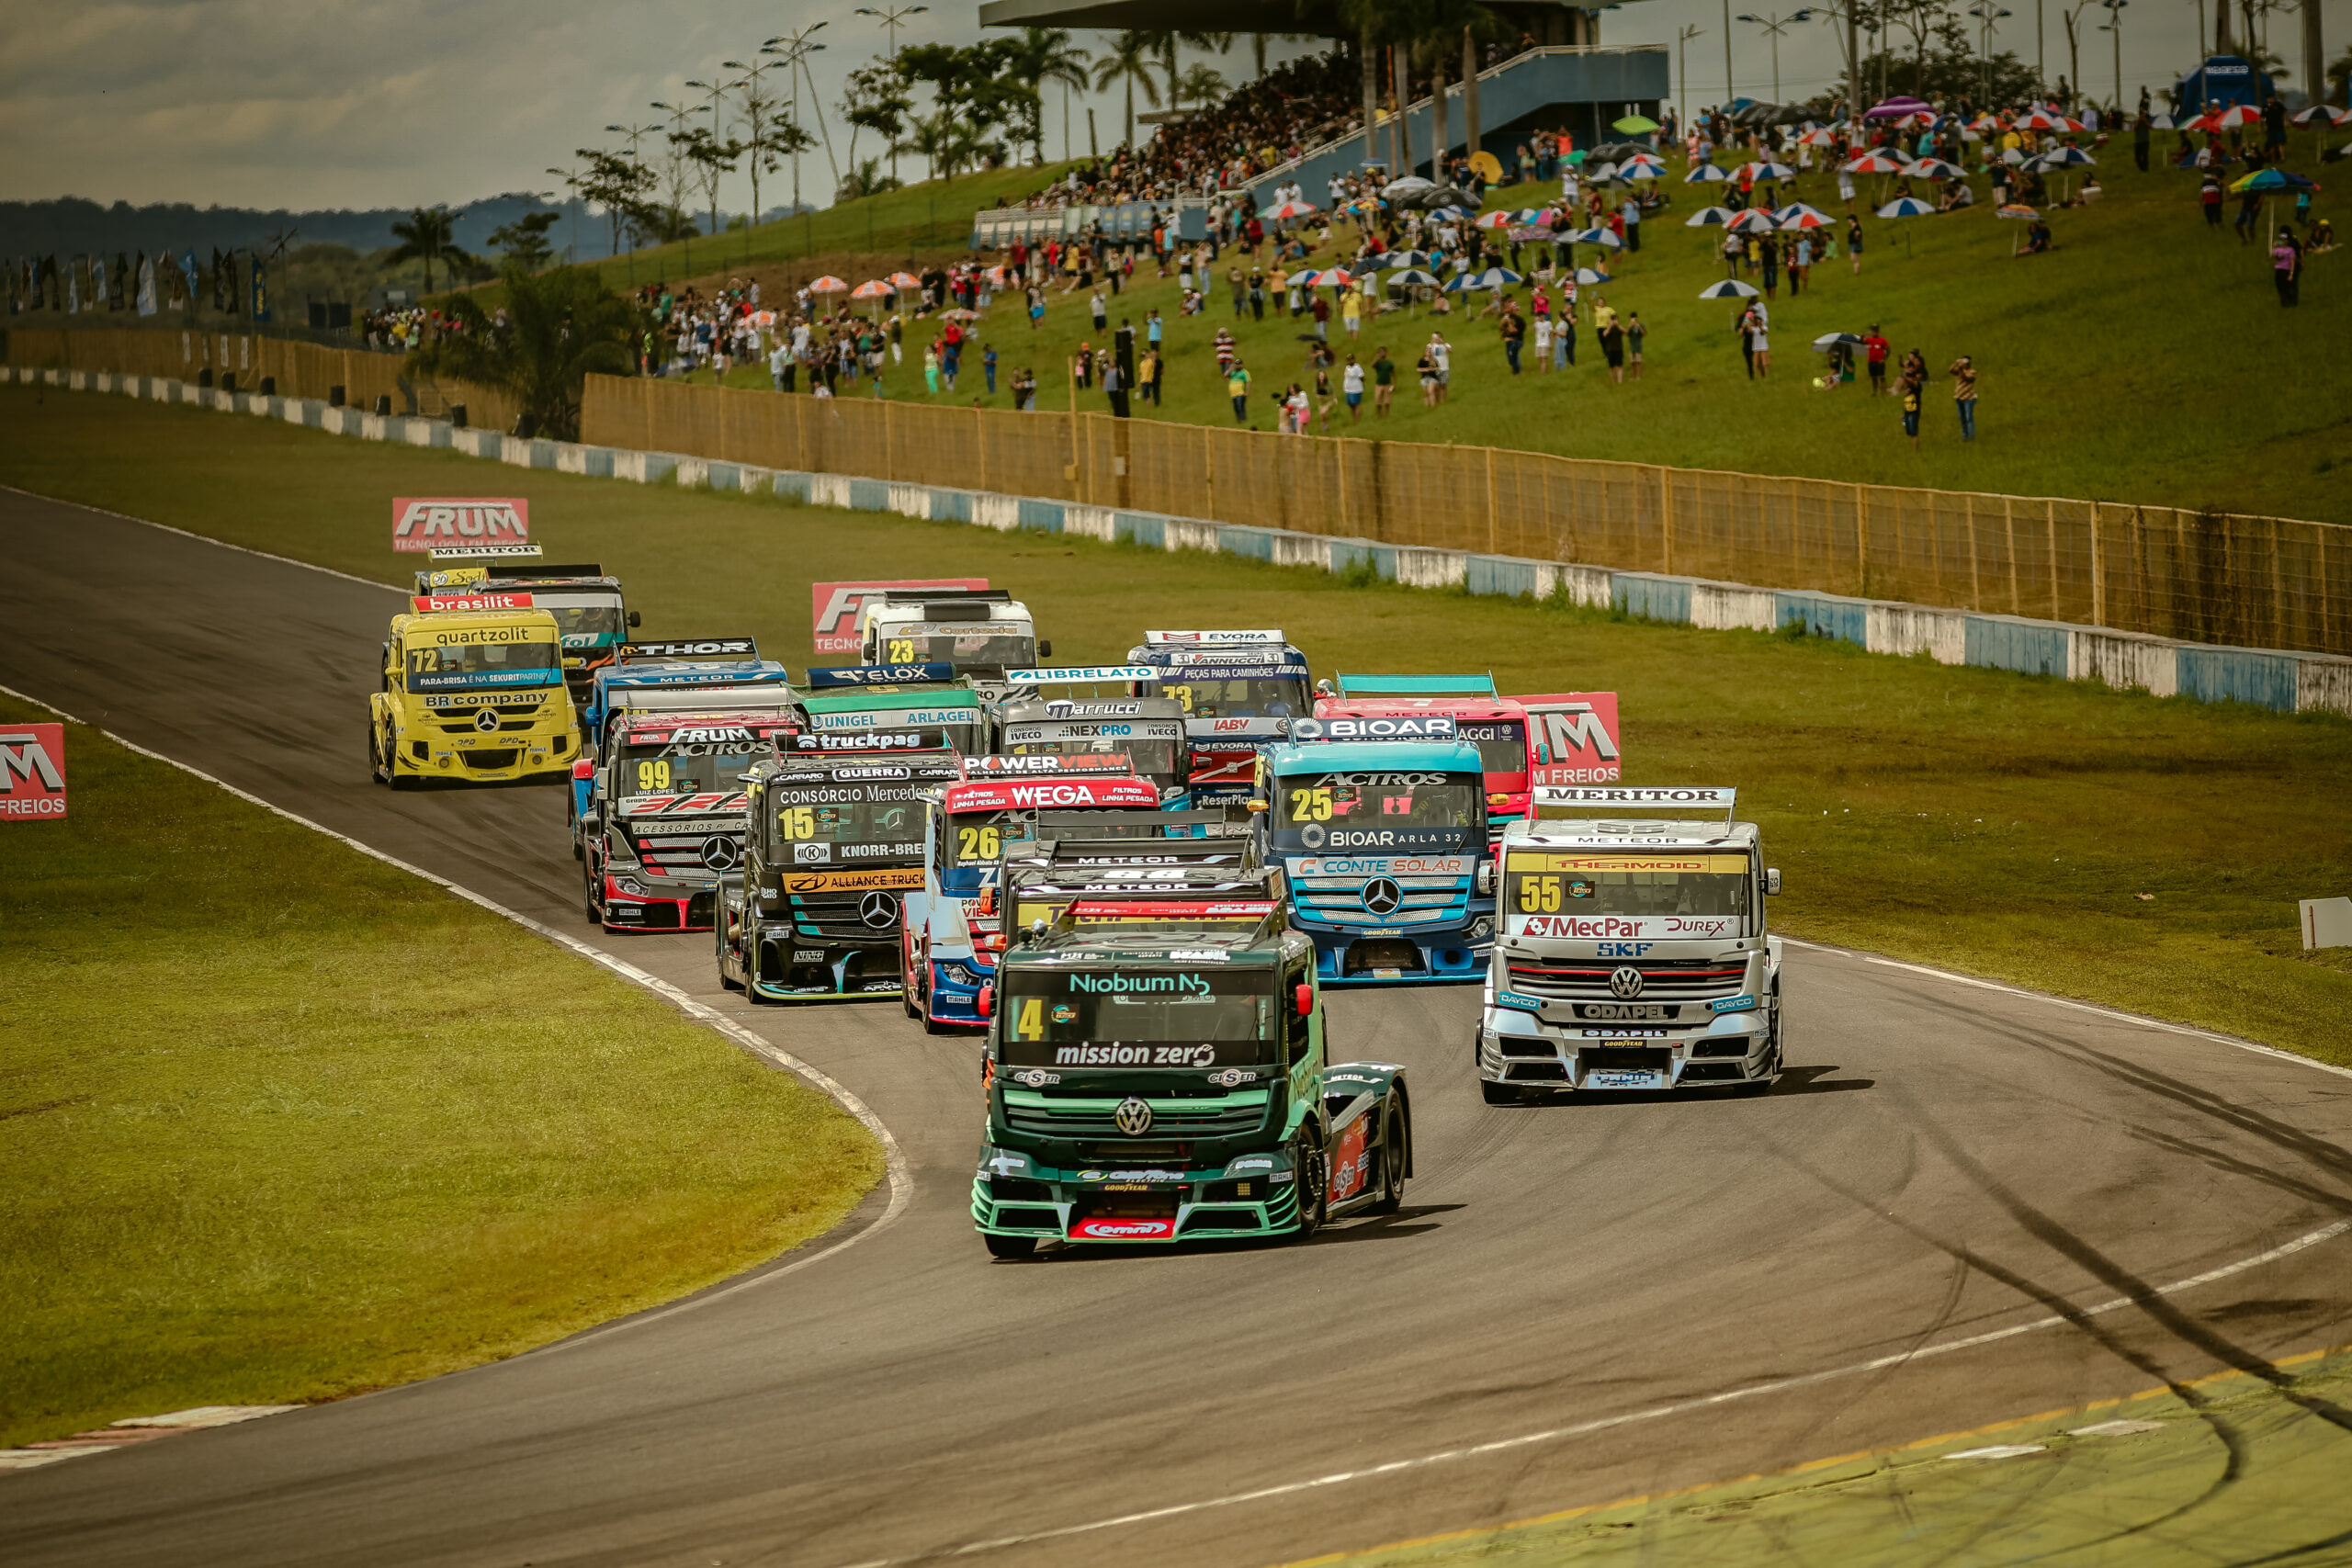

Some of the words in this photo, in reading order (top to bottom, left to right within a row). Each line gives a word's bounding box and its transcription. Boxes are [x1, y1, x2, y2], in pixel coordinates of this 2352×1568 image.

[396, 502, 527, 537] FRUM
[435, 547, 539, 556] MERITOR
[430, 595, 514, 612] brasilit
[436, 627, 529, 647] quartzolit
[639, 642, 749, 656] THOR
[889, 640, 914, 663] 23
[413, 650, 437, 673] 72
[420, 676, 468, 686] PARA-BRISA
[475, 674, 488, 683] NA
[660, 674, 734, 683] METEOR
[1035, 668, 1151, 680] LIBRELATO
[1184, 669, 1210, 680] PEÇAS
[1212, 669, 1230, 678] PARA
[1232, 666, 1273, 677] CAMINHÕES
[425, 696, 450, 707] BR
[454, 693, 549, 706] company
[1162, 685, 1193, 712] 73
[825, 715, 877, 728] UNIGEL
[908, 710, 974, 724] ARLAGEL
[1330, 718, 1453, 736] BIOAR
[500, 737, 519, 745] DPD
[669, 728, 753, 743] FRUM
[820, 733, 921, 750] truckpag
[1011, 732, 1042, 740] IVECO
[659, 741, 772, 758] ACTROS
[639, 761, 671, 790] 99
[779, 773, 824, 781] CARRARO
[839, 768, 904, 779] GUERRA
[1314, 773, 1447, 787] ACTROS
[1552, 766, 1619, 784] FREIOS
[781, 786, 862, 805] CONSÓRCIO
[1011, 785, 1096, 807] WEGA
[1545, 788, 1720, 801] MERITOR
[953, 799, 975, 809] LINHA
[976, 798, 1006, 807] PESADA
[1291, 788, 1333, 822] 25
[634, 823, 713, 834] ACESSÓRIOS
[778, 807, 816, 840] 15
[958, 827, 1000, 860] 26
[1329, 830, 1395, 846] BIOAR
[1398, 833, 1437, 843] ARLA
[1445, 833, 1462, 842] 32
[1323, 859, 1388, 873] CONTE
[1392, 859, 1462, 872] SOLAR
[1558, 861, 1702, 870] THERMOID
[831, 875, 889, 888] ALLIANCE
[891, 874, 925, 885] TRUCK
[1521, 875, 1561, 913] 55
[1363, 928, 1402, 936] GOODYEAR
[1553, 917, 1642, 937] MecPar
[1597, 942, 1654, 957] SKF
[1500, 994, 1537, 1008] DAYCO
[1715, 997, 1753, 1010] DAYCO
[1584, 1004, 1668, 1020] ODAPEL
[1017, 999, 1043, 1042] 4
[1604, 1039, 1644, 1047] GOODYEAR
[1056, 1041, 1150, 1065] mission
[1153, 1043, 1216, 1067] zero
[1014, 1069, 1061, 1088] CISER
[1208, 1069, 1257, 1088] CISER
[1104, 1183, 1148, 1192] GOODYEAR
